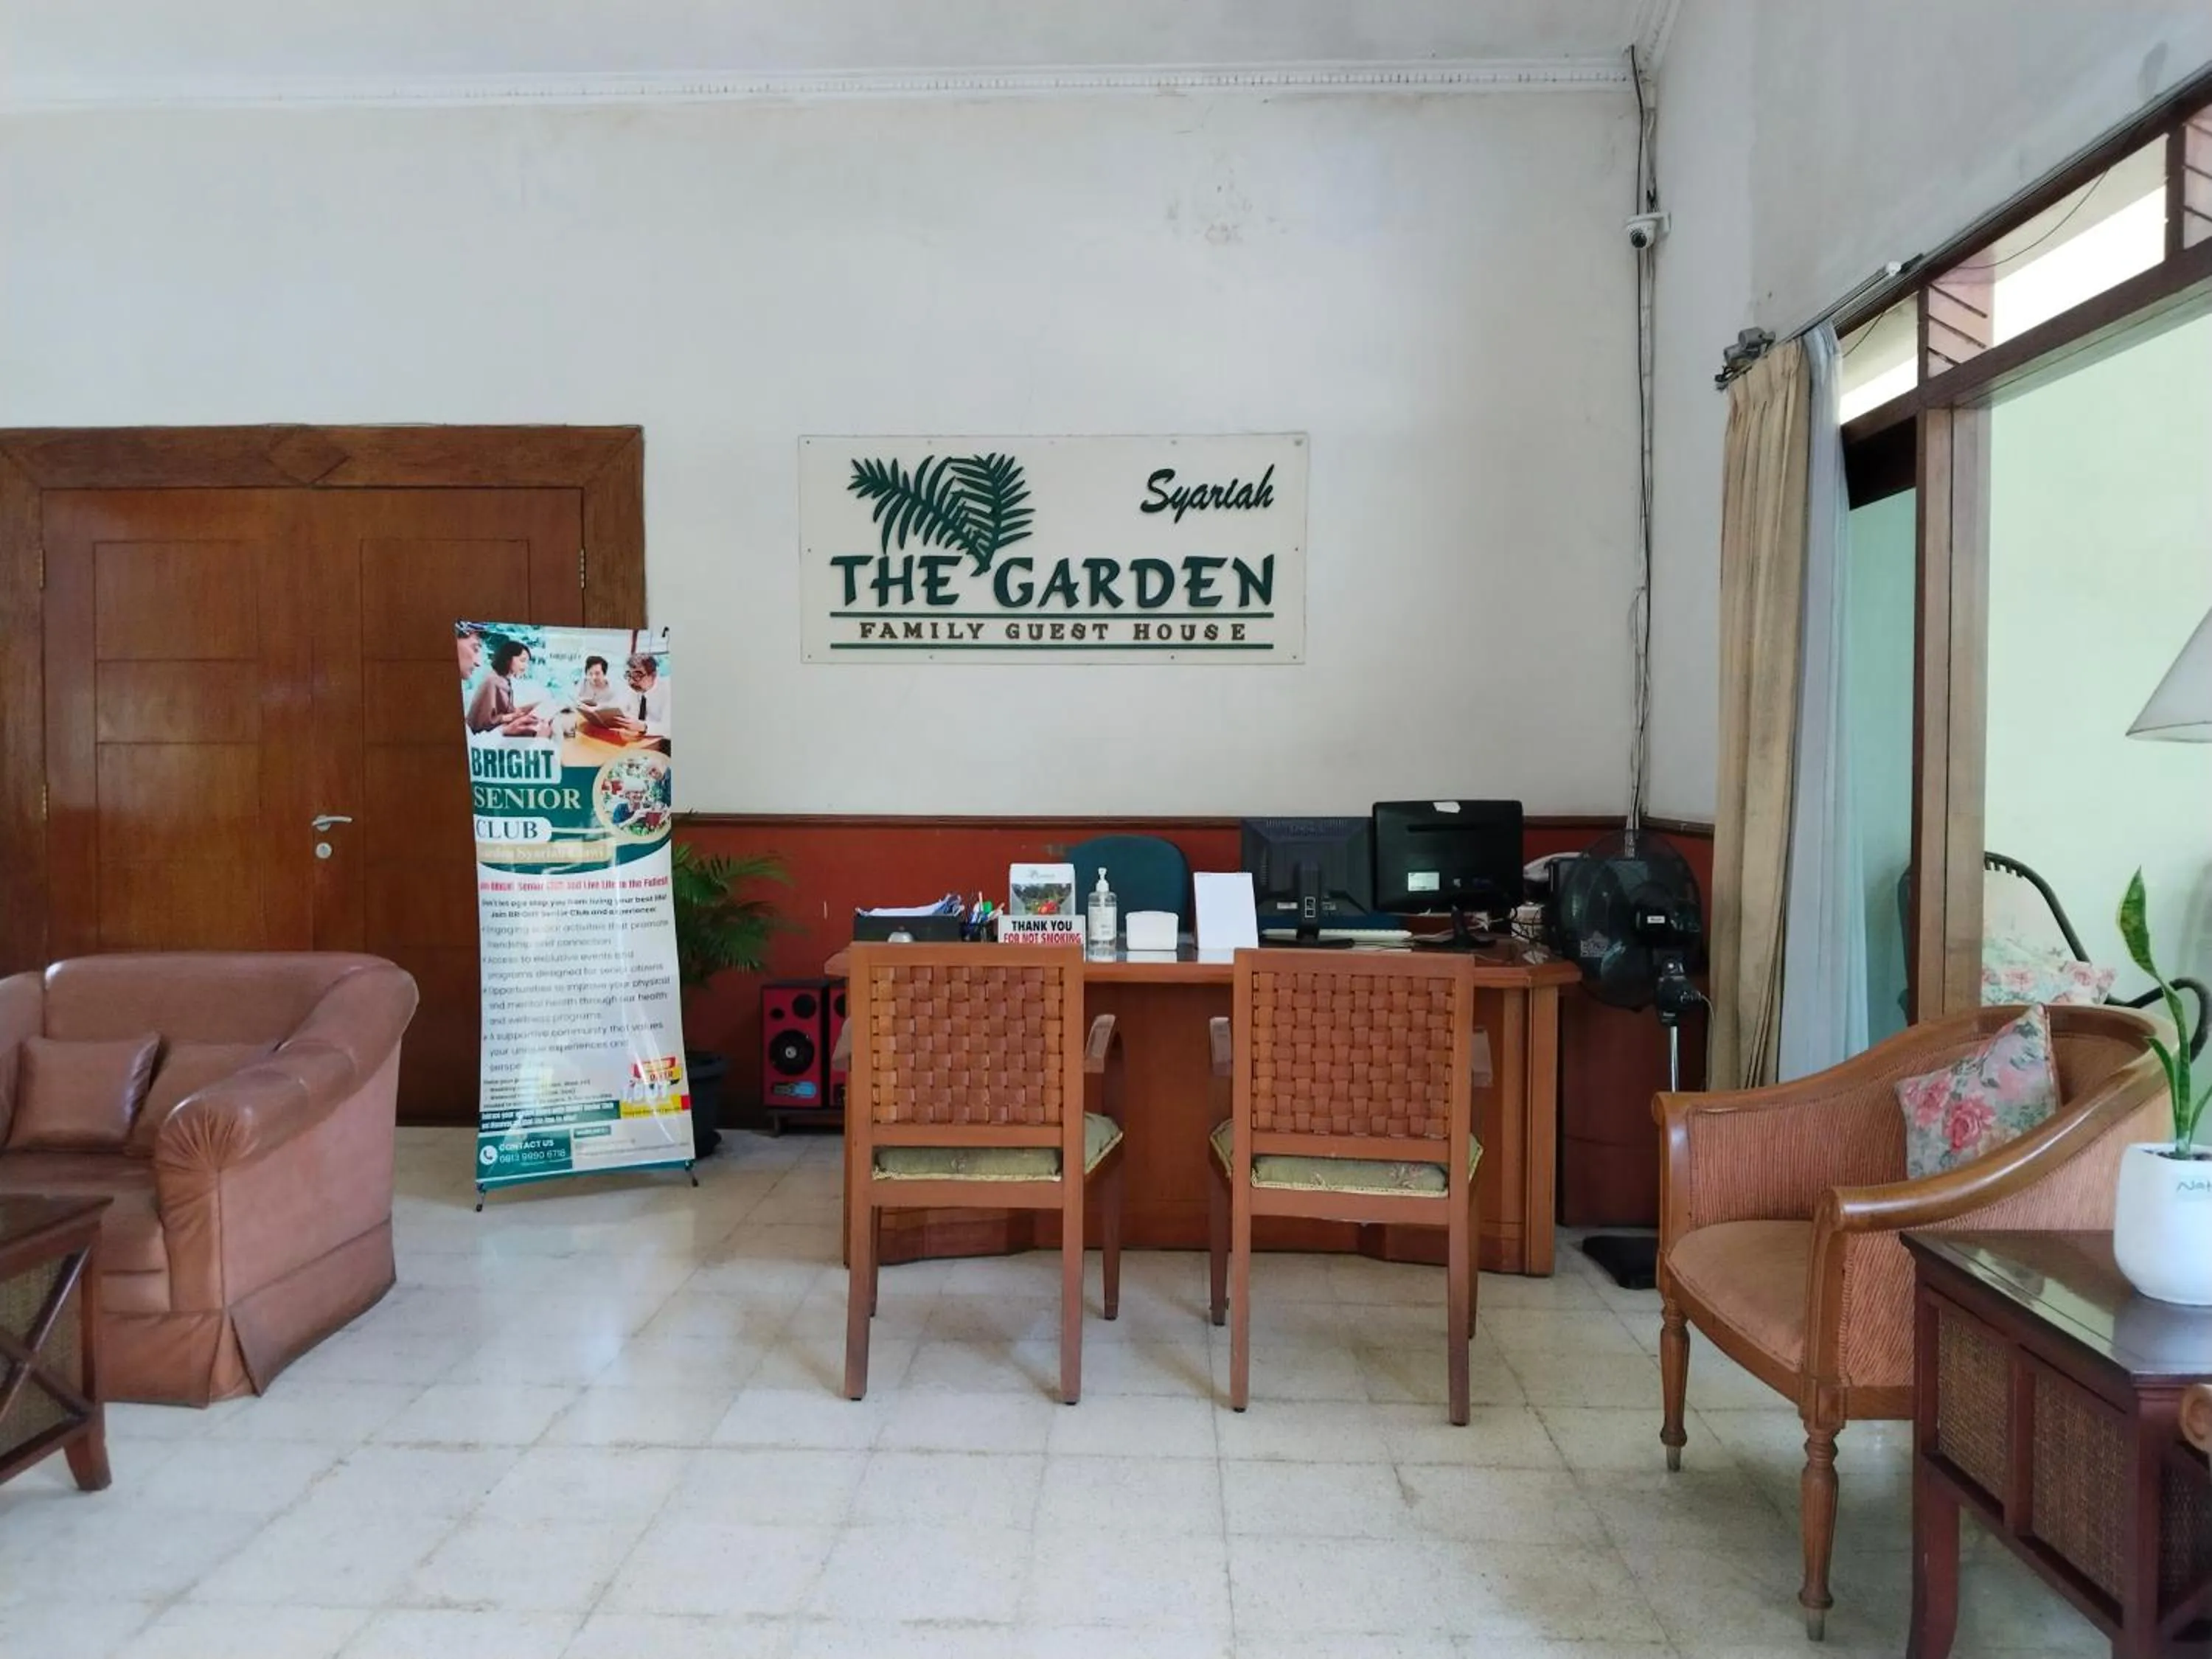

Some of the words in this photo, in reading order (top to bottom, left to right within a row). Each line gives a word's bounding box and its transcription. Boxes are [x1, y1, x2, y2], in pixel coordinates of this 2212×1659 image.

[1140, 464, 1275, 524] Syariah
[830, 555, 962, 607] THE
[992, 554, 1275, 608] GARDEN
[860, 621, 984, 640] FAMILY
[1005, 622, 1109, 641] GUEST
[1133, 622, 1247, 641] HOUSE
[471, 747, 554, 779] BRIGHT
[474, 787, 582, 810] SENIOR
[476, 819, 538, 839] CLUB
[1011, 920, 1048, 931] THANK
[1050, 920, 1073, 931] YOU
[1004, 933, 1020, 943] FOR
[1021, 933, 1040, 943] NOT
[1042, 933, 1082, 943] SMOKING
[498, 1139, 541, 1152] CONTACT
[542, 1139, 554, 1147] US
